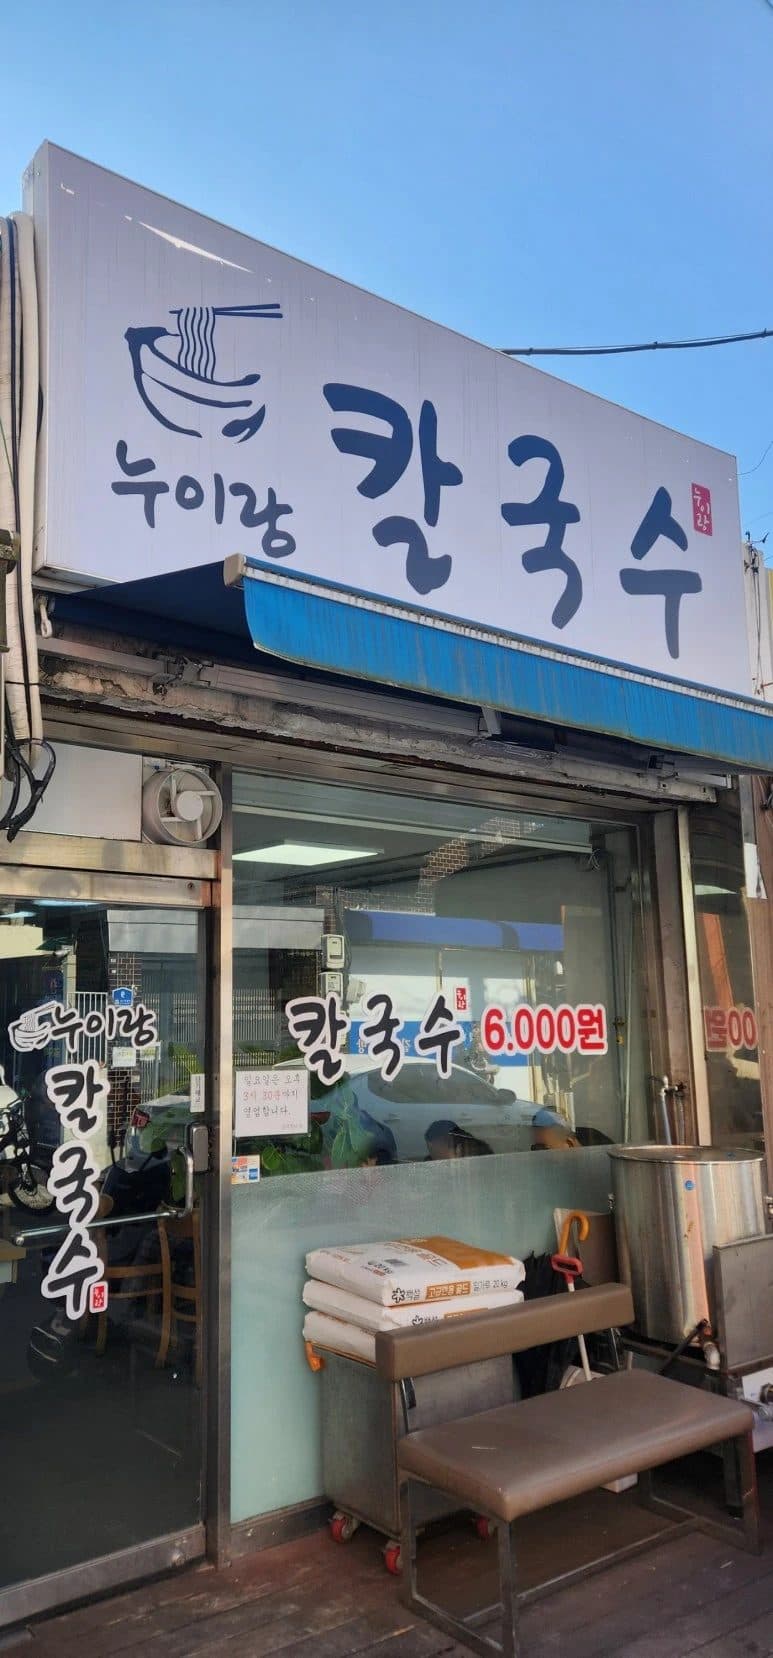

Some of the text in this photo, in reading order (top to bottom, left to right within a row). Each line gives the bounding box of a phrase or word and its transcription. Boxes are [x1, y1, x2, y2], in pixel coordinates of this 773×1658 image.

[111, 440, 297, 558] 누이랑
[323, 382, 703, 659] 칼국수
[51, 1005, 154, 1047] 누이랑
[289, 993, 605, 1080] 칼국수 6.000원
[47, 1065, 106, 1313] 칼국수
